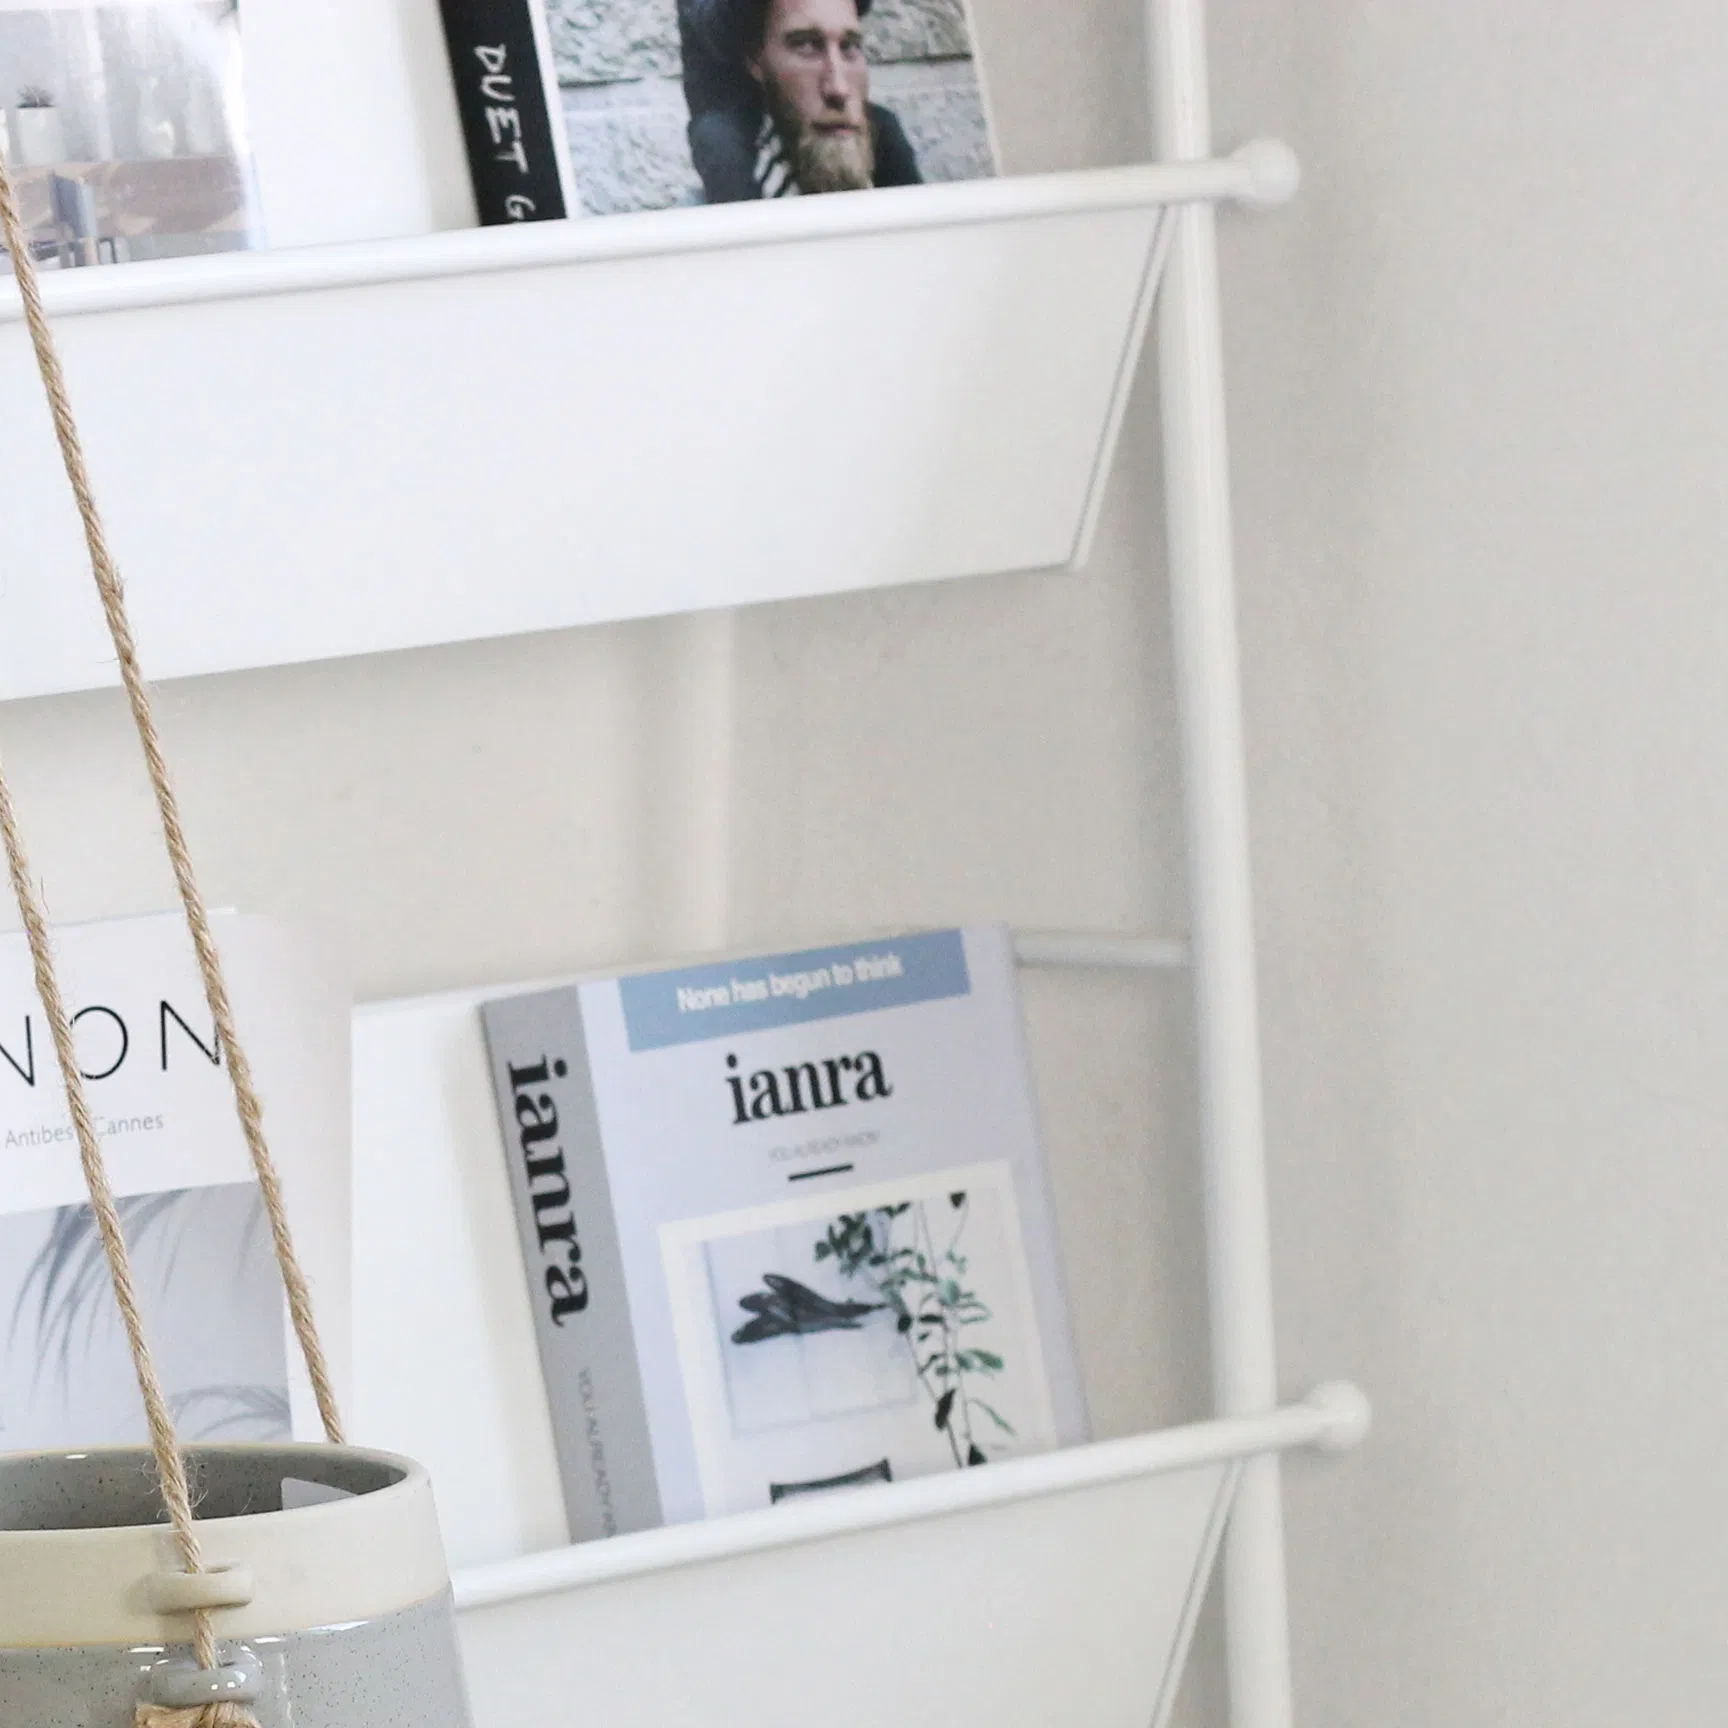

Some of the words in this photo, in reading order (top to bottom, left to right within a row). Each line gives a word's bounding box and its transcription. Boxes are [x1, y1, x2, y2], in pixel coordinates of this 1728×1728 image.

[474, 43, 529, 174] DUET
[676, 985, 731, 1014] None
[730, 977, 769, 1002] has
[769, 971, 832, 999] begun
[831, 961, 854, 986] to
[725, 1050, 894, 1125] ianra
[4, 1123, 74, 1150] Antibes
[507, 1054, 589, 1327] ianra
